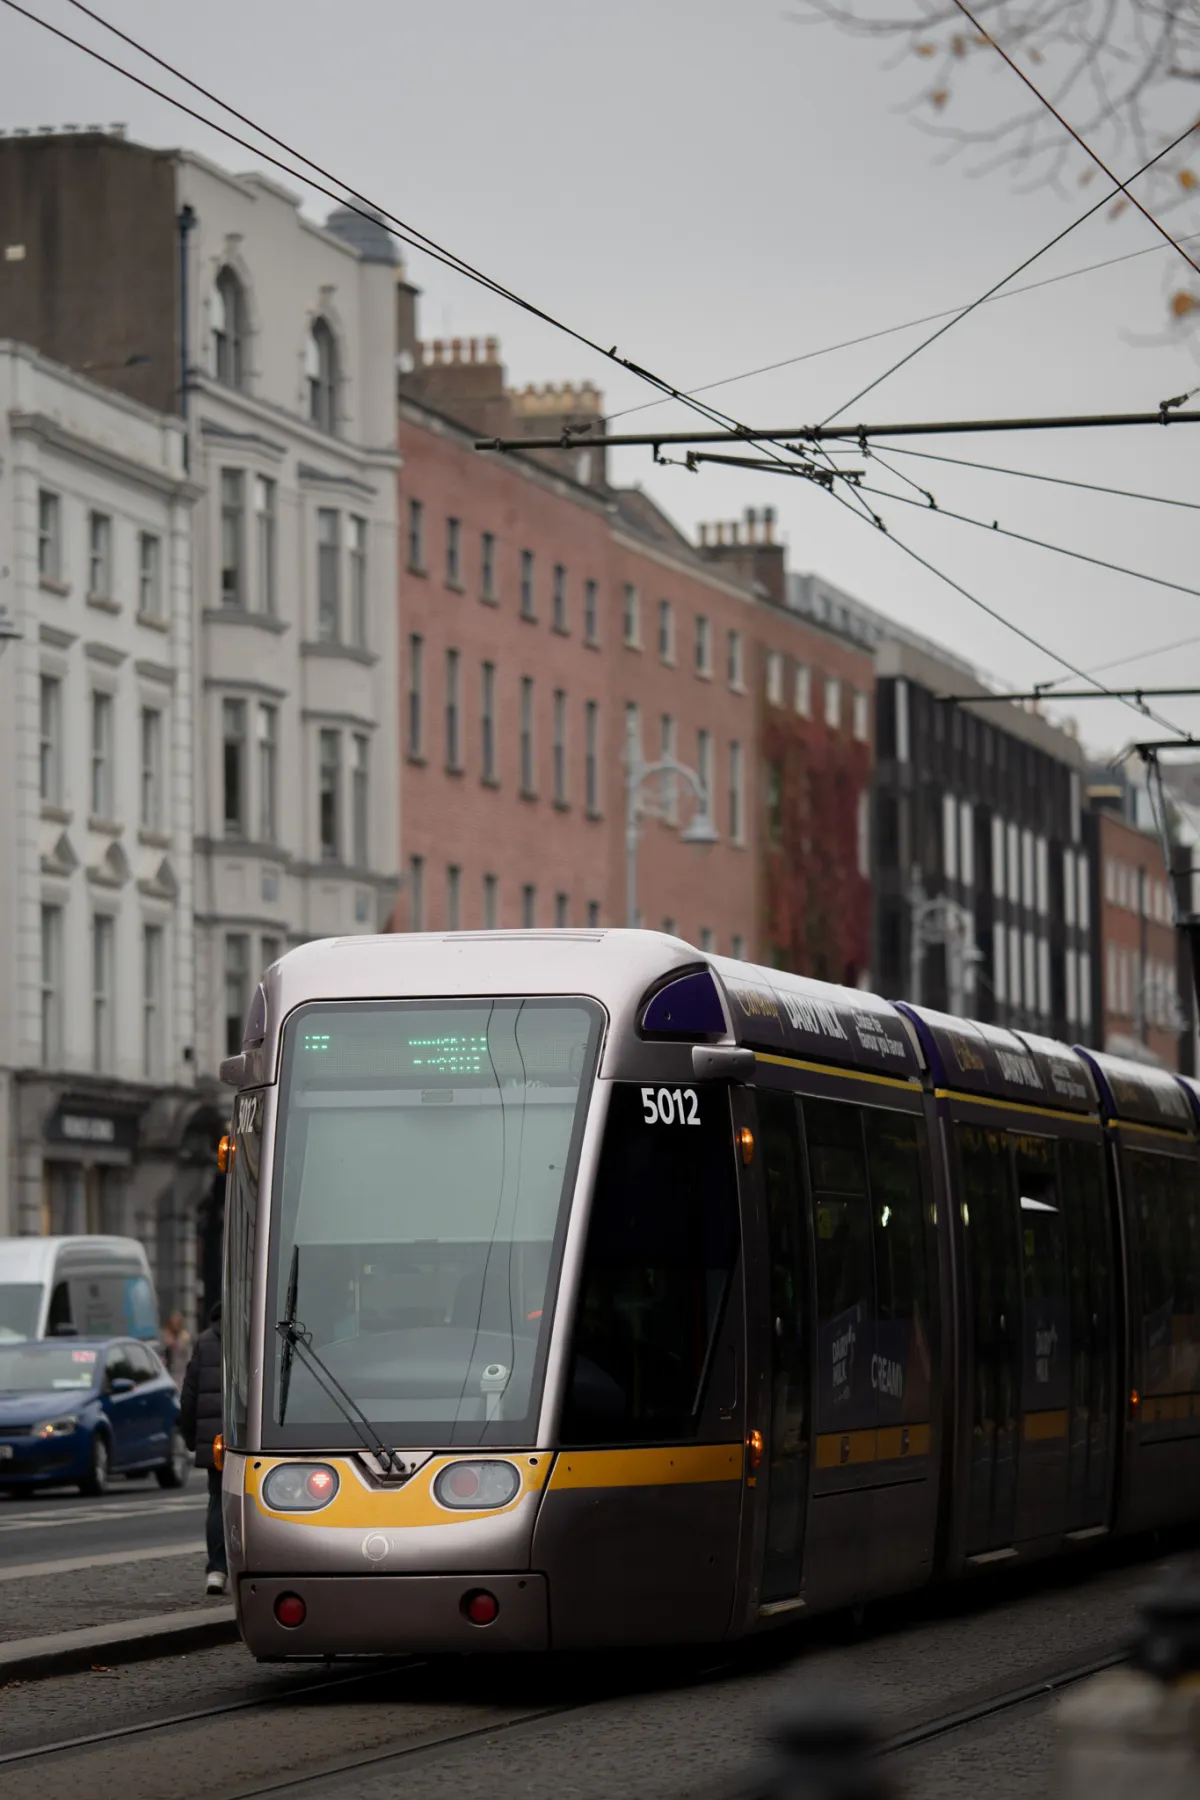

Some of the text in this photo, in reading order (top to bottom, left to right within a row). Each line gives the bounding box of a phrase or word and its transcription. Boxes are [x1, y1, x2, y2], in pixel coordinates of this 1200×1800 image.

[778, 992, 849, 1041] DAIRY MILK
[236, 1097, 257, 1135] 5012
[640, 1087, 701, 1126] 5012
[832, 1334, 849, 1365] DAIRY
[832, 1358, 848, 1387] MILK
